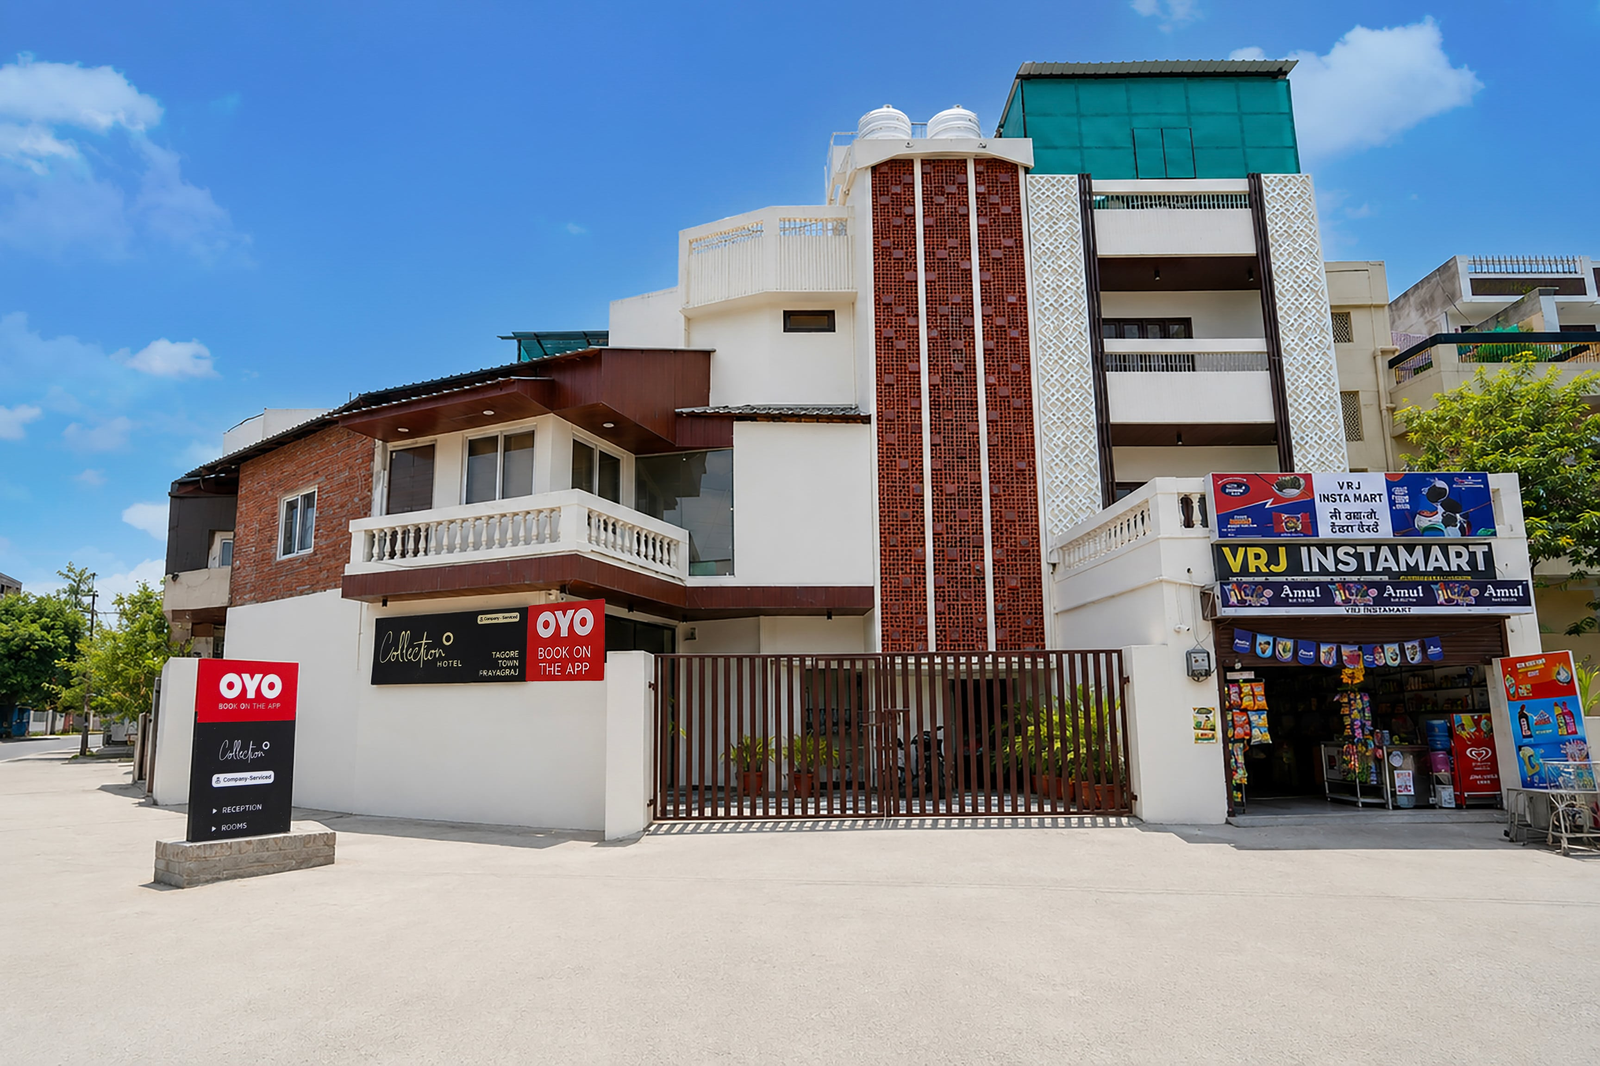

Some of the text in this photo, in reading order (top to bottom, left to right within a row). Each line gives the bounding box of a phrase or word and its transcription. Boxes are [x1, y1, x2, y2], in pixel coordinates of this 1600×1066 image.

[1337, 481, 1361, 490] VRJ
[1319, 493, 1351, 503] INSTA
[1353, 493, 1383, 503] MART
[1221, 545, 1489, 573] VRJ INSTAMART
[1280, 585, 1321, 598] Amul
[1383, 585, 1424, 598] Amul
[1484, 584, 1524, 597] Amul
[536, 607, 595, 639] OYO
[380, 630, 445, 668] Collection
[491, 650, 519, 659] TAGORE
[538, 645, 591, 660] BOOK ON
[437, 660, 462, 668] HOTEL
[538, 662, 590, 675] THE APP
[219, 672, 283, 699] OYO
[218, 702, 281, 710] BOOK ON THE APP
[218, 739, 265, 763] Collection
[222, 803, 263, 814] RECEPTION
[221, 822, 247, 832] ROOMS
